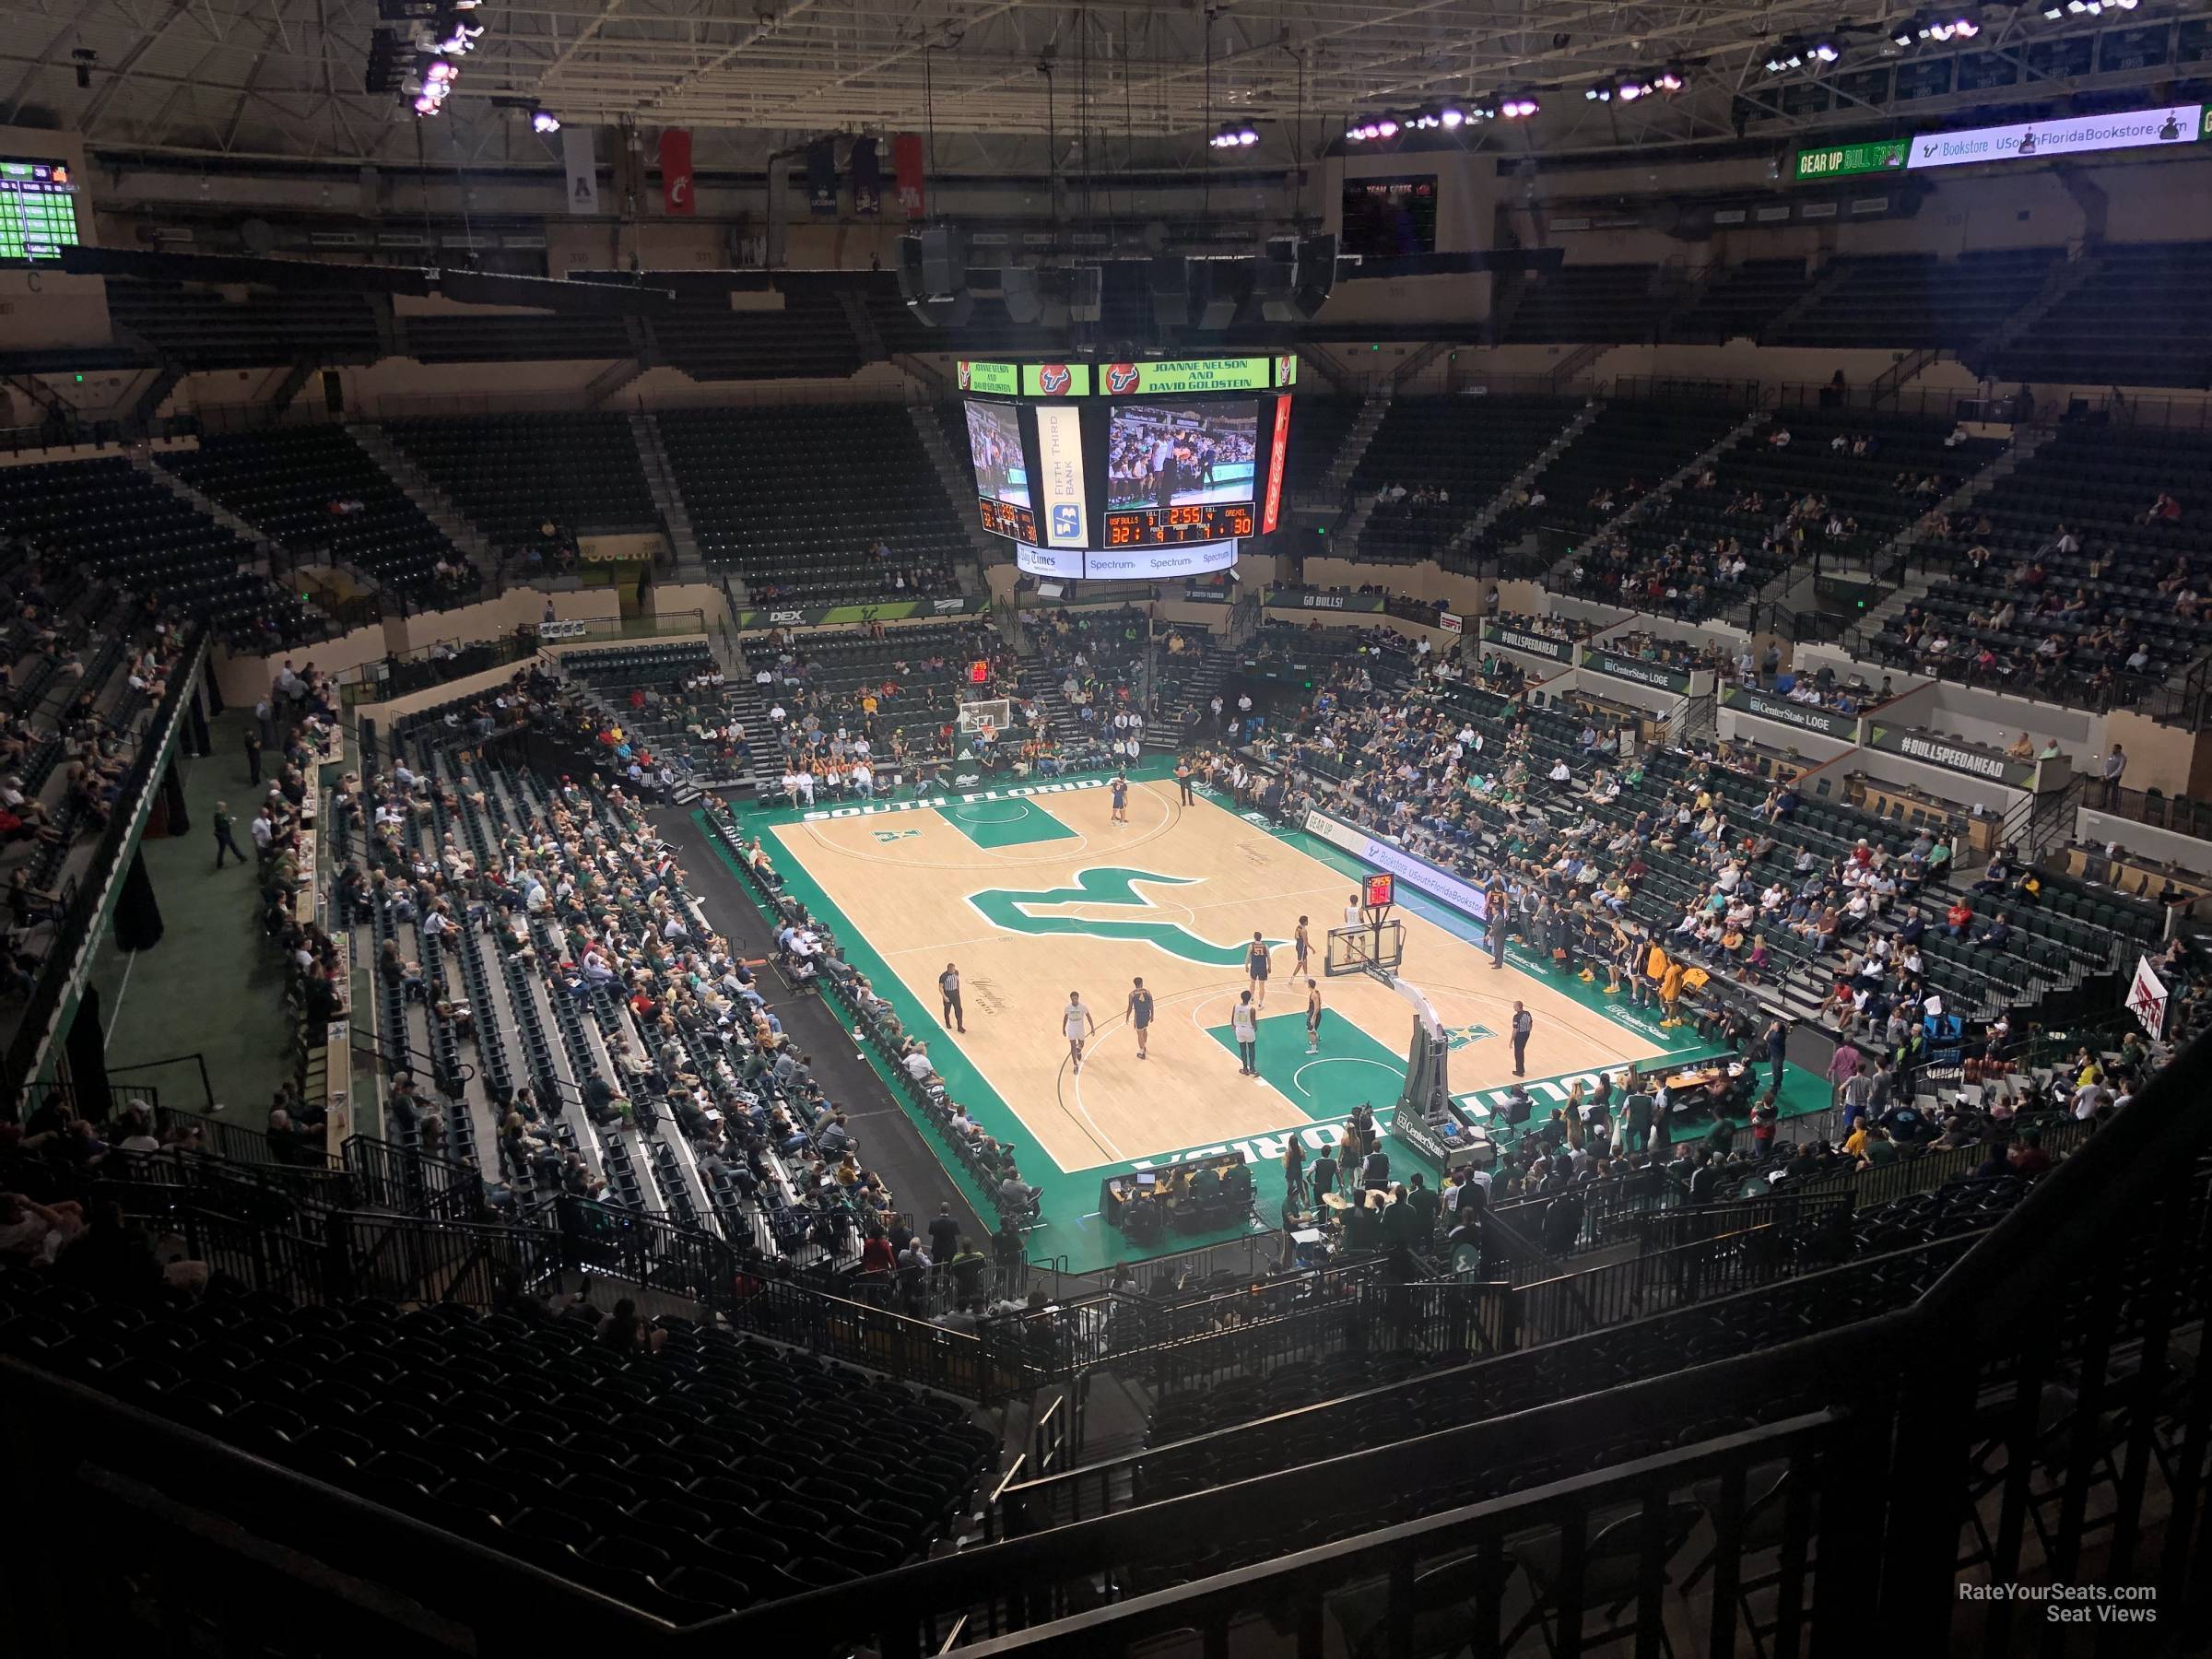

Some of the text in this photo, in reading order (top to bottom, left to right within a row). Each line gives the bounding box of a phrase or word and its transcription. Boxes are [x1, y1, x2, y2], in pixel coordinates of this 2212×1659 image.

[1801, 152, 1826, 173] GEAR
[1829, 151, 1843, 171] UP
[1844, 147, 1870, 170] BULL
[1943, 140, 1989, 156] Bookstore
[1996, 121, 2187, 149] USouhFloridaBookstore.cm
[1153, 360, 1248, 372] JOANNE NELSON
[1189, 371, 1213, 381] AND
[1149, 379, 1252, 392] DAVID GOLDSTEIN
[1051, 416, 1063, 496] FIFTH THIRD
[1065, 461, 1074, 496] BANK
[1148, 516, 1154, 525] 3
[1170, 508, 1201, 524] 2:55
[1207, 512, 1213, 521] 4
[1234, 519, 1251, 534] 30
[1112, 528, 1130, 543] 32
[1030, 550, 1055, 566] Times
[1090, 560, 1135, 571] Spectrum
[1150, 558, 1191, 569] Spectrum
[1303, 596, 1344, 608] GO BULLS!
[770, 610, 804, 622] DEX
[1501, 631, 1559, 656] #BULLSPEEDAHEAD
[1612, 662, 1668, 687] CenterState LOGE
[1760, 702, 1830, 731] CenterState LOGE
[1901, 737, 2005, 777] #BULLSPEEDAHEAD
[803, 797, 947, 821] SOUTH
[962, 777, 1134, 803] FLORIDA
[1309, 815, 1334, 836] GEAR UP
[1379, 852, 1408, 875] Bookstore
[1406, 1121, 1444, 1159] CenterState
